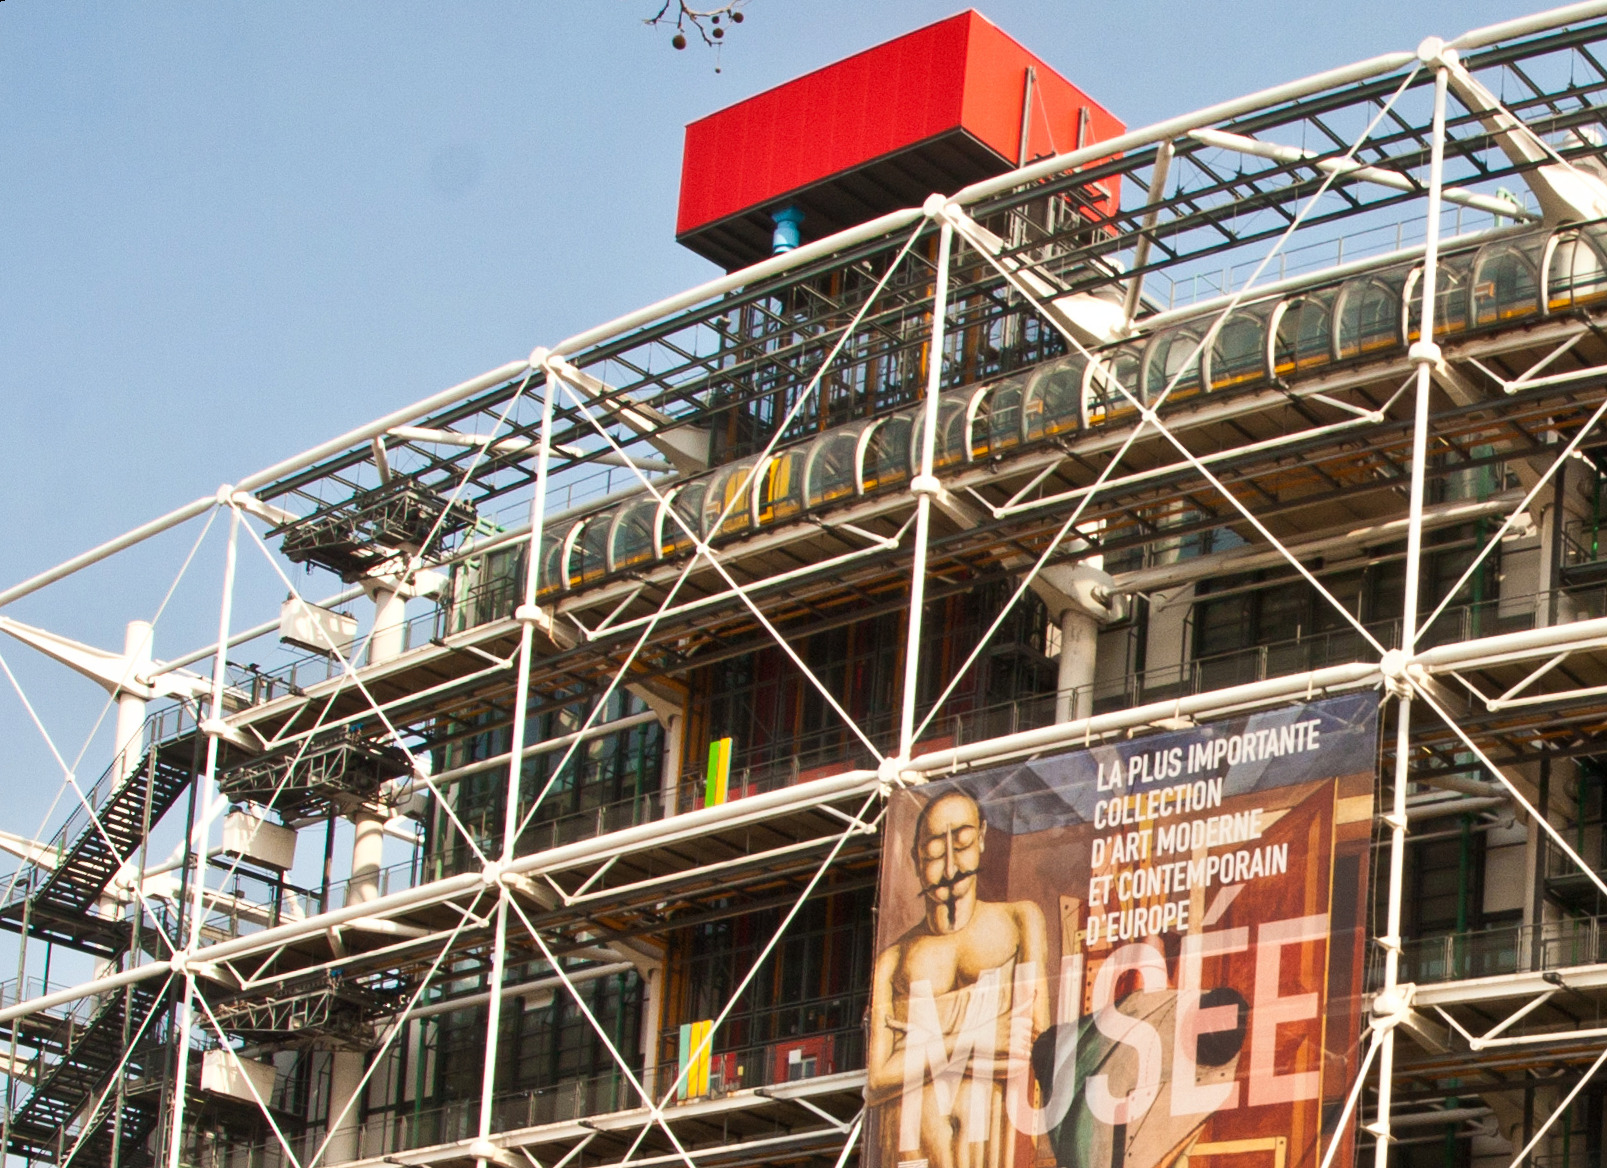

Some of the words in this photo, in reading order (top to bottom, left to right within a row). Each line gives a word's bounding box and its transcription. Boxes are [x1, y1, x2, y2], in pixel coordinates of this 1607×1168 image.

[1097, 761, 1122, 791] LA
[1128, 748, 1182, 786] PLUS
[1187, 719, 1321, 774] IMPORTANTE
[1094, 778, 1223, 830] COLLECTION
[1091, 829, 1152, 869] D'ART
[1157, 808, 1263, 856] MODERNE
[1089, 875, 1113, 907] ET
[1118, 843, 1288, 899] CONTEMPORAIN
[1086, 899, 1190, 946] D'EUROPE
[898, 883, 1329, 1152] MUSÉE
